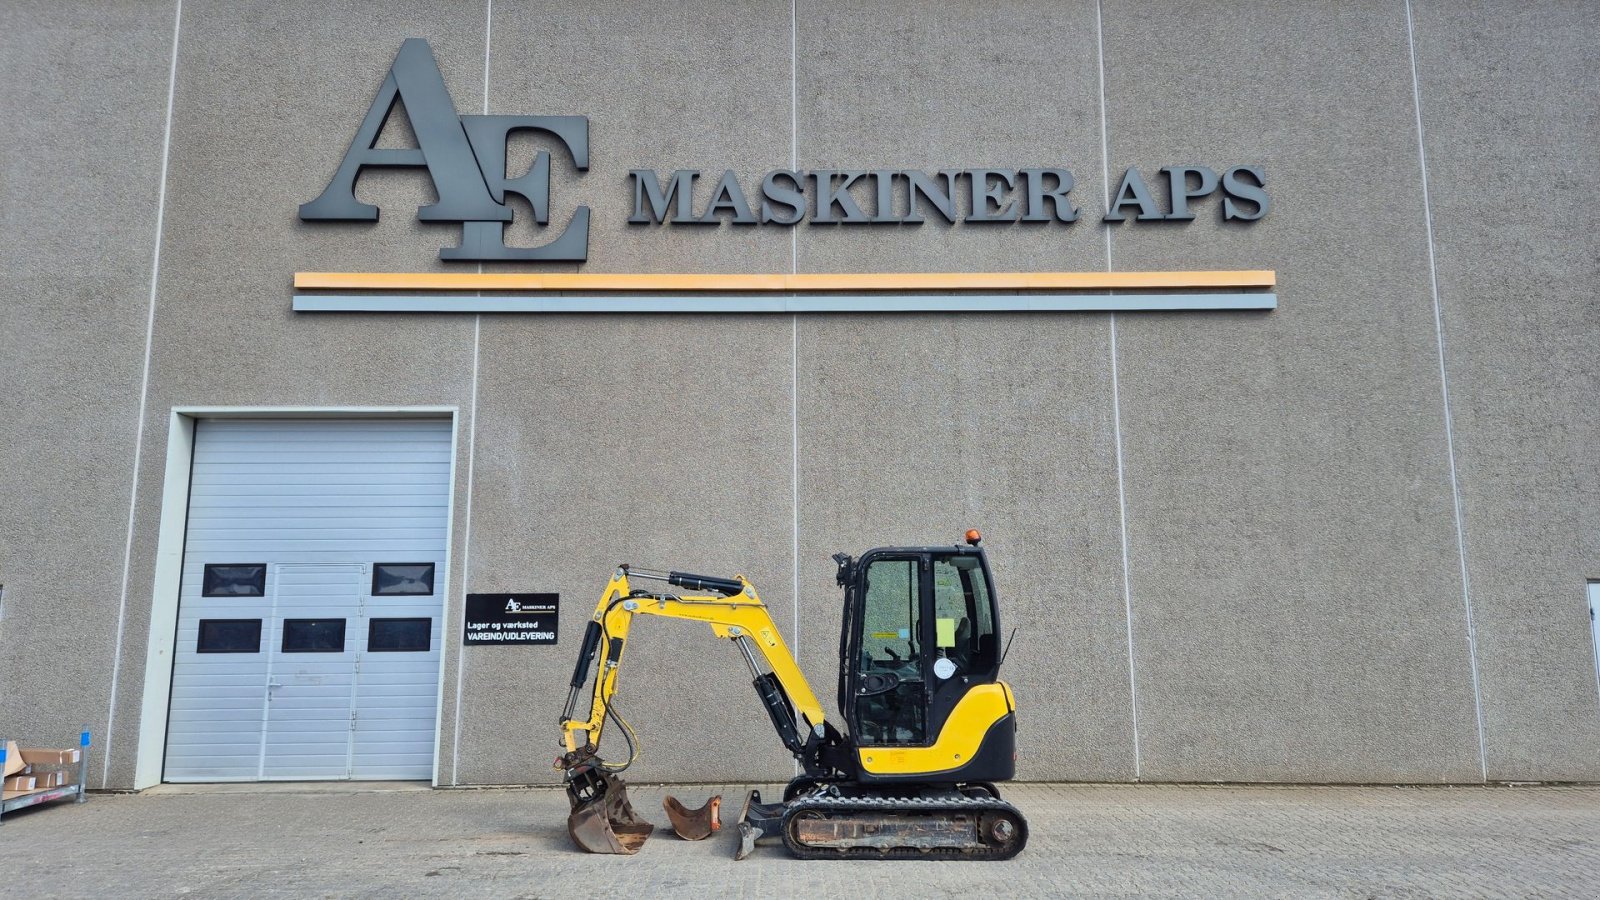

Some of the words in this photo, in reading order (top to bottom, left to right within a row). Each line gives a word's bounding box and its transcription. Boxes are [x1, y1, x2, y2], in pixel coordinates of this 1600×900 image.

[299, 38, 590, 262] AE
[628, 168, 1080, 226] MASKINER
[1103, 164, 1270, 223] APS
[467, 621, 490, 630] Lager
[502, 621, 538, 629] værksted
[467, 632, 555, 641] VAREIND/UDLEVERING
